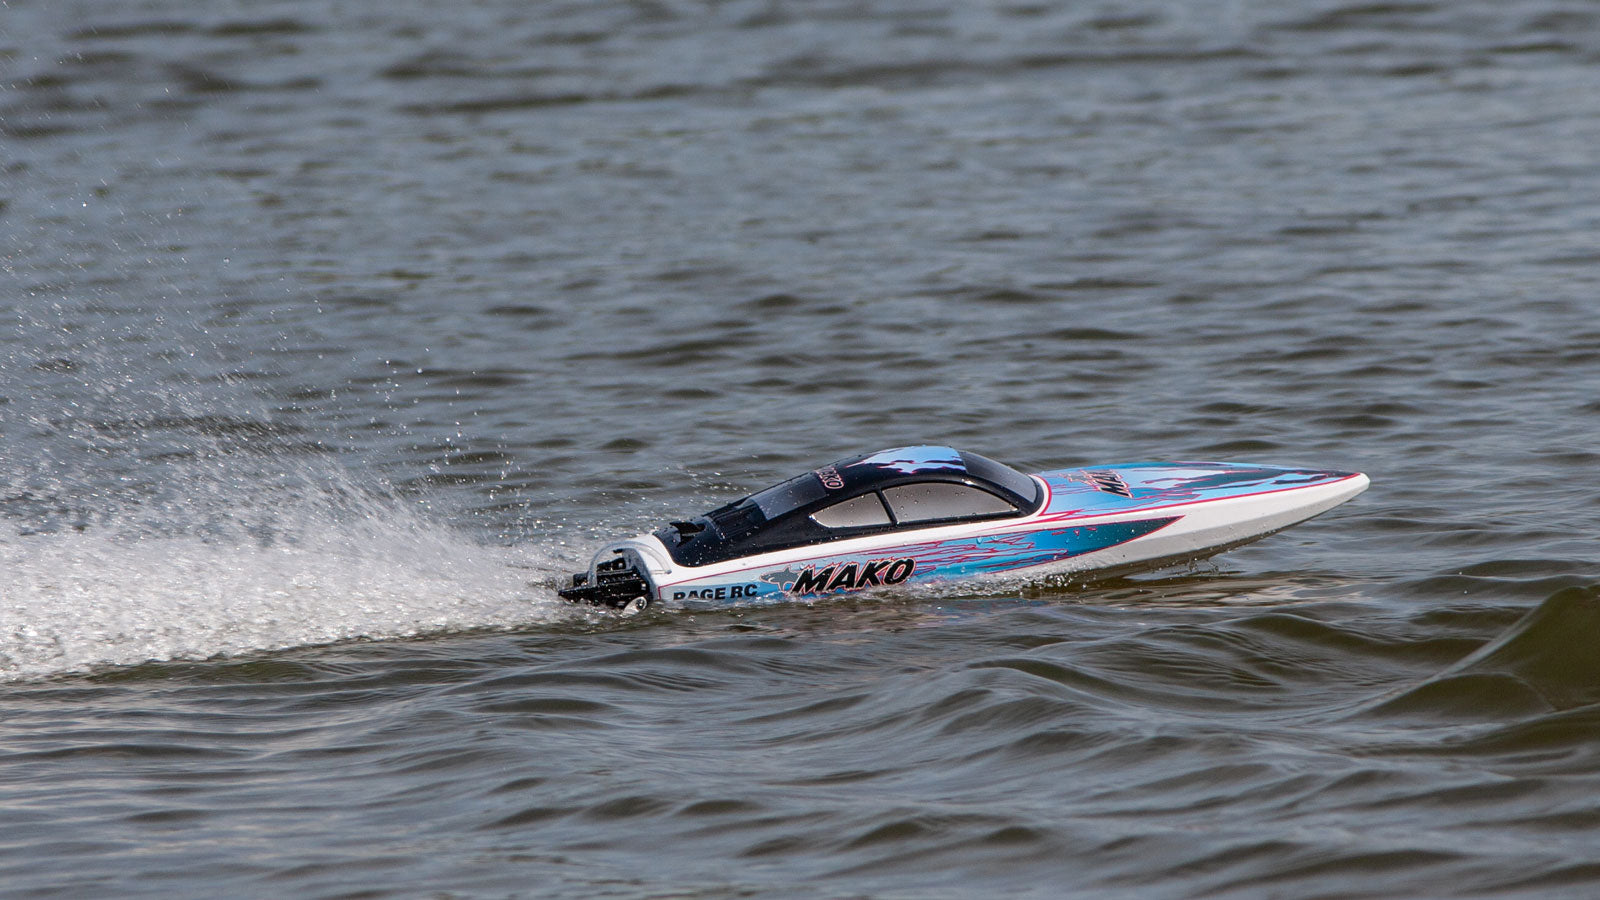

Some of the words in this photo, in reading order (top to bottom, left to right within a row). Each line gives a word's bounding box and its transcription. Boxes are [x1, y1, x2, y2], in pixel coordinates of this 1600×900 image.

[1081, 469, 1134, 498] MA
[790, 557, 916, 594] MAKO
[673, 587, 726, 600] RAGE
[730, 584, 758, 599] RC
